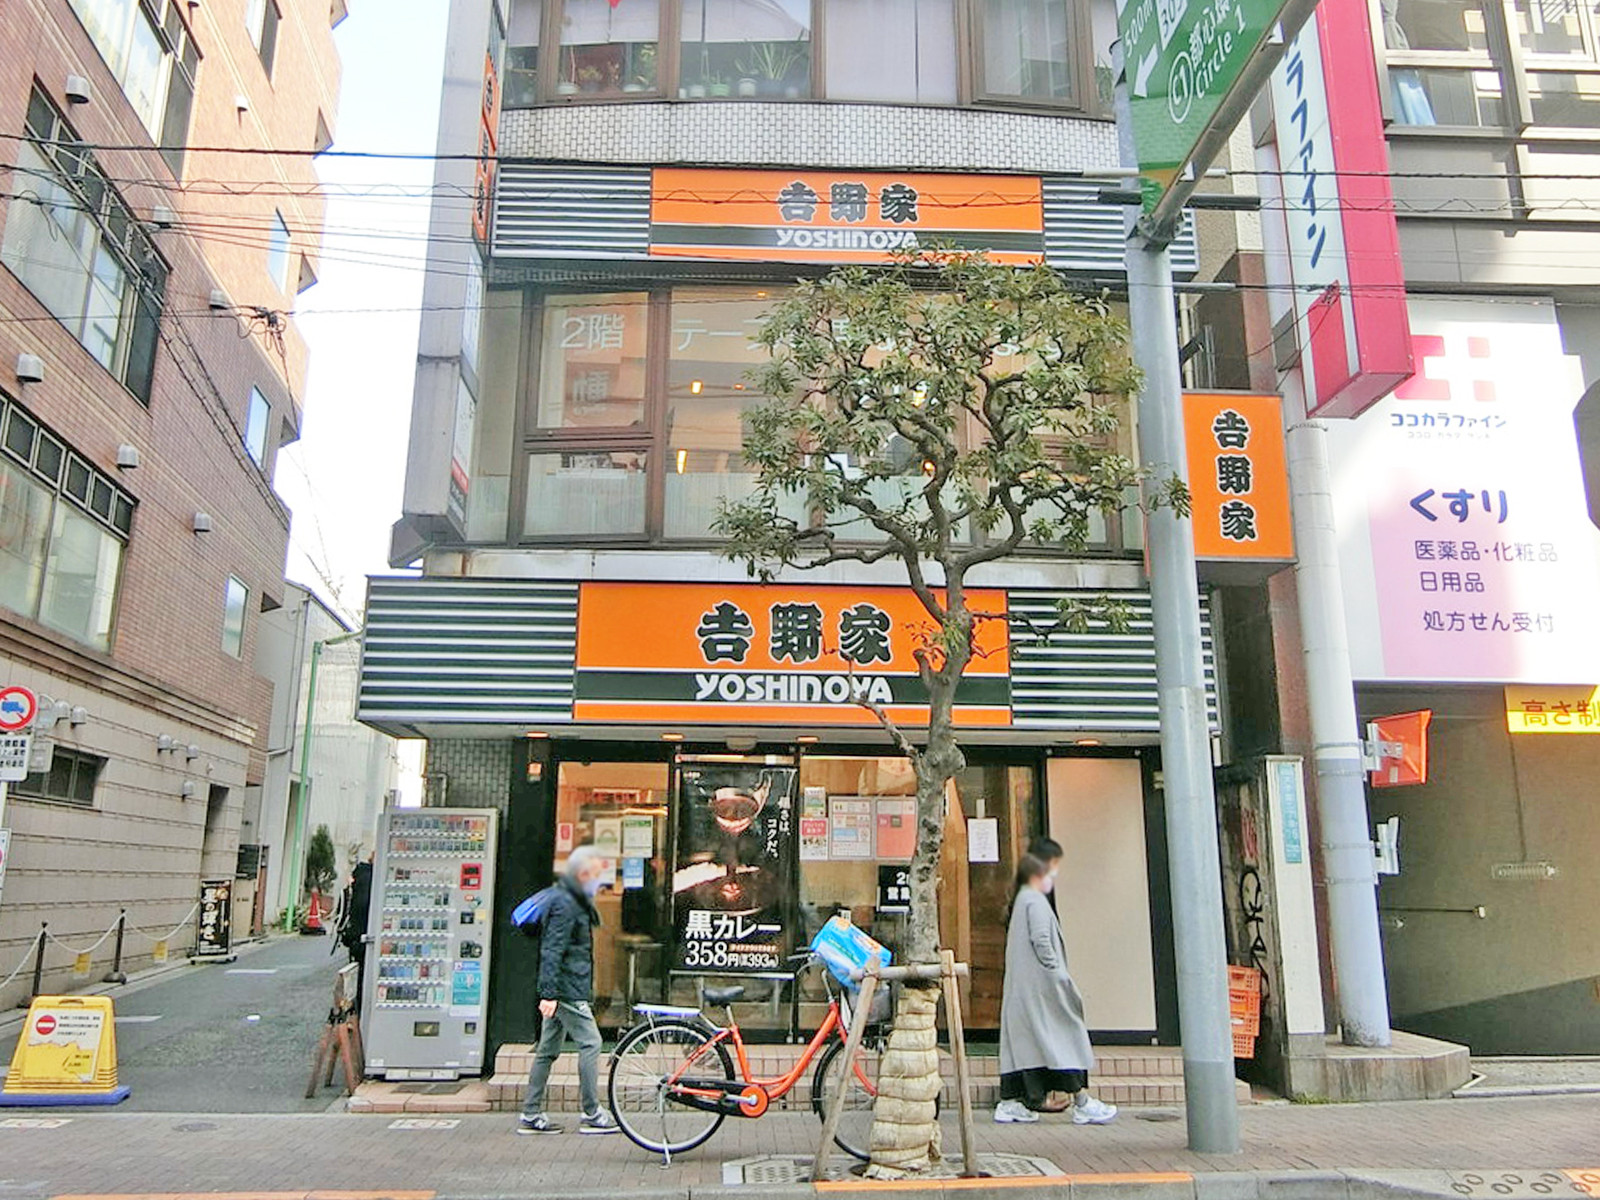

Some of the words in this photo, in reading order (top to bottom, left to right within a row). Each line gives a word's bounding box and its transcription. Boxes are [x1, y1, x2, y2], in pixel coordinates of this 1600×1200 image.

[1195, 31, 1233, 99] Circle
[1235, 4, 1246, 35] 1
[778, 181, 918, 224] 吉野家
[776, 229, 919, 249] YOSHINOYA
[560, 313, 625, 350] 2階
[1390, 411, 1507, 428] ココカラファイン
[1211, 408, 1258, 543] 吉野家
[1409, 488, 1509, 524] くすり
[1419, 571, 1486, 593] 日用品
[696, 601, 893, 665] 吉野家
[1423, 610, 1555, 633] 処方せん受付
[695, 674, 893, 703] YOSHINOYA
[1521, 699, 1600, 727] 高さ制
[685, 909, 782, 939] 黒カレー
